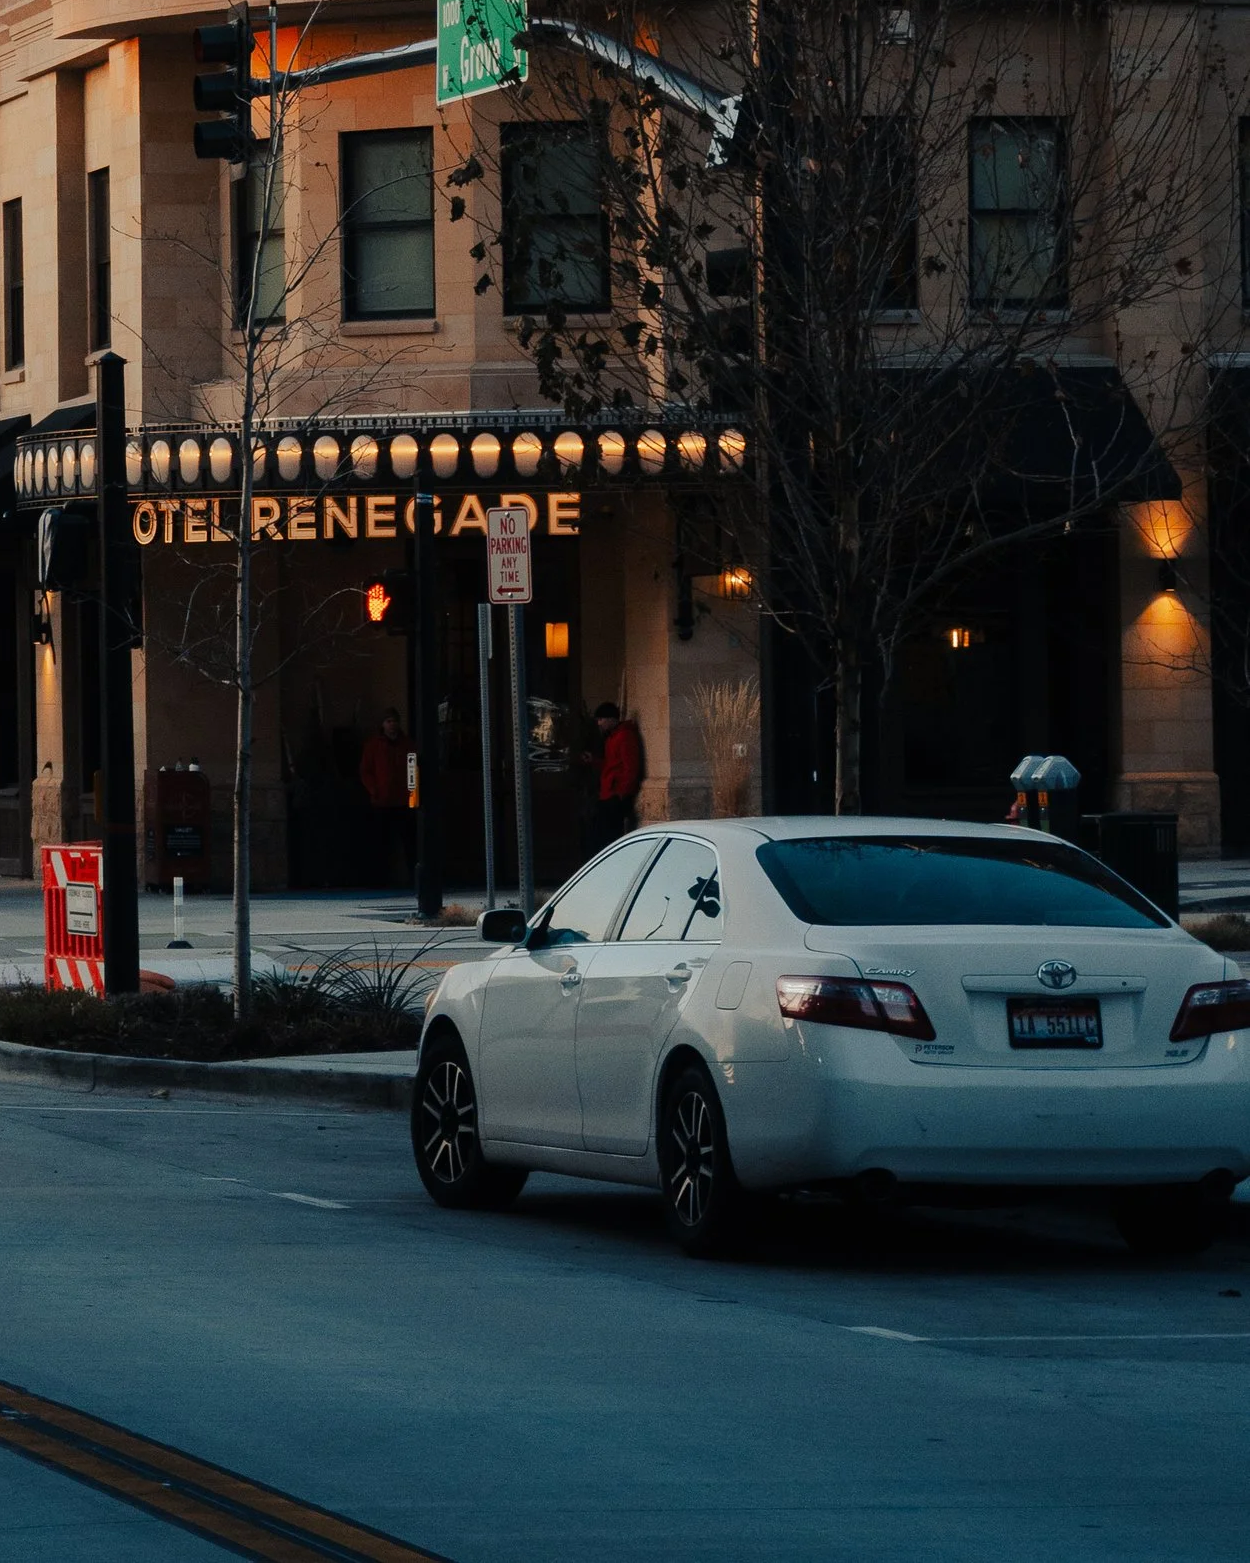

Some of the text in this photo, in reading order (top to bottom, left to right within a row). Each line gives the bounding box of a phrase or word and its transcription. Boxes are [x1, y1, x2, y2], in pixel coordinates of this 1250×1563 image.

[442, 0, 461, 28] 1000
[460, 35, 501, 85] Grove
[132, 497, 234, 545] OTEL
[500, 517, 516, 535] NO
[490, 537, 527, 555] PARKING
[501, 557, 518, 569] ANY
[500, 571, 520, 583] TIME
[864, 966, 918, 978] CAMRY
